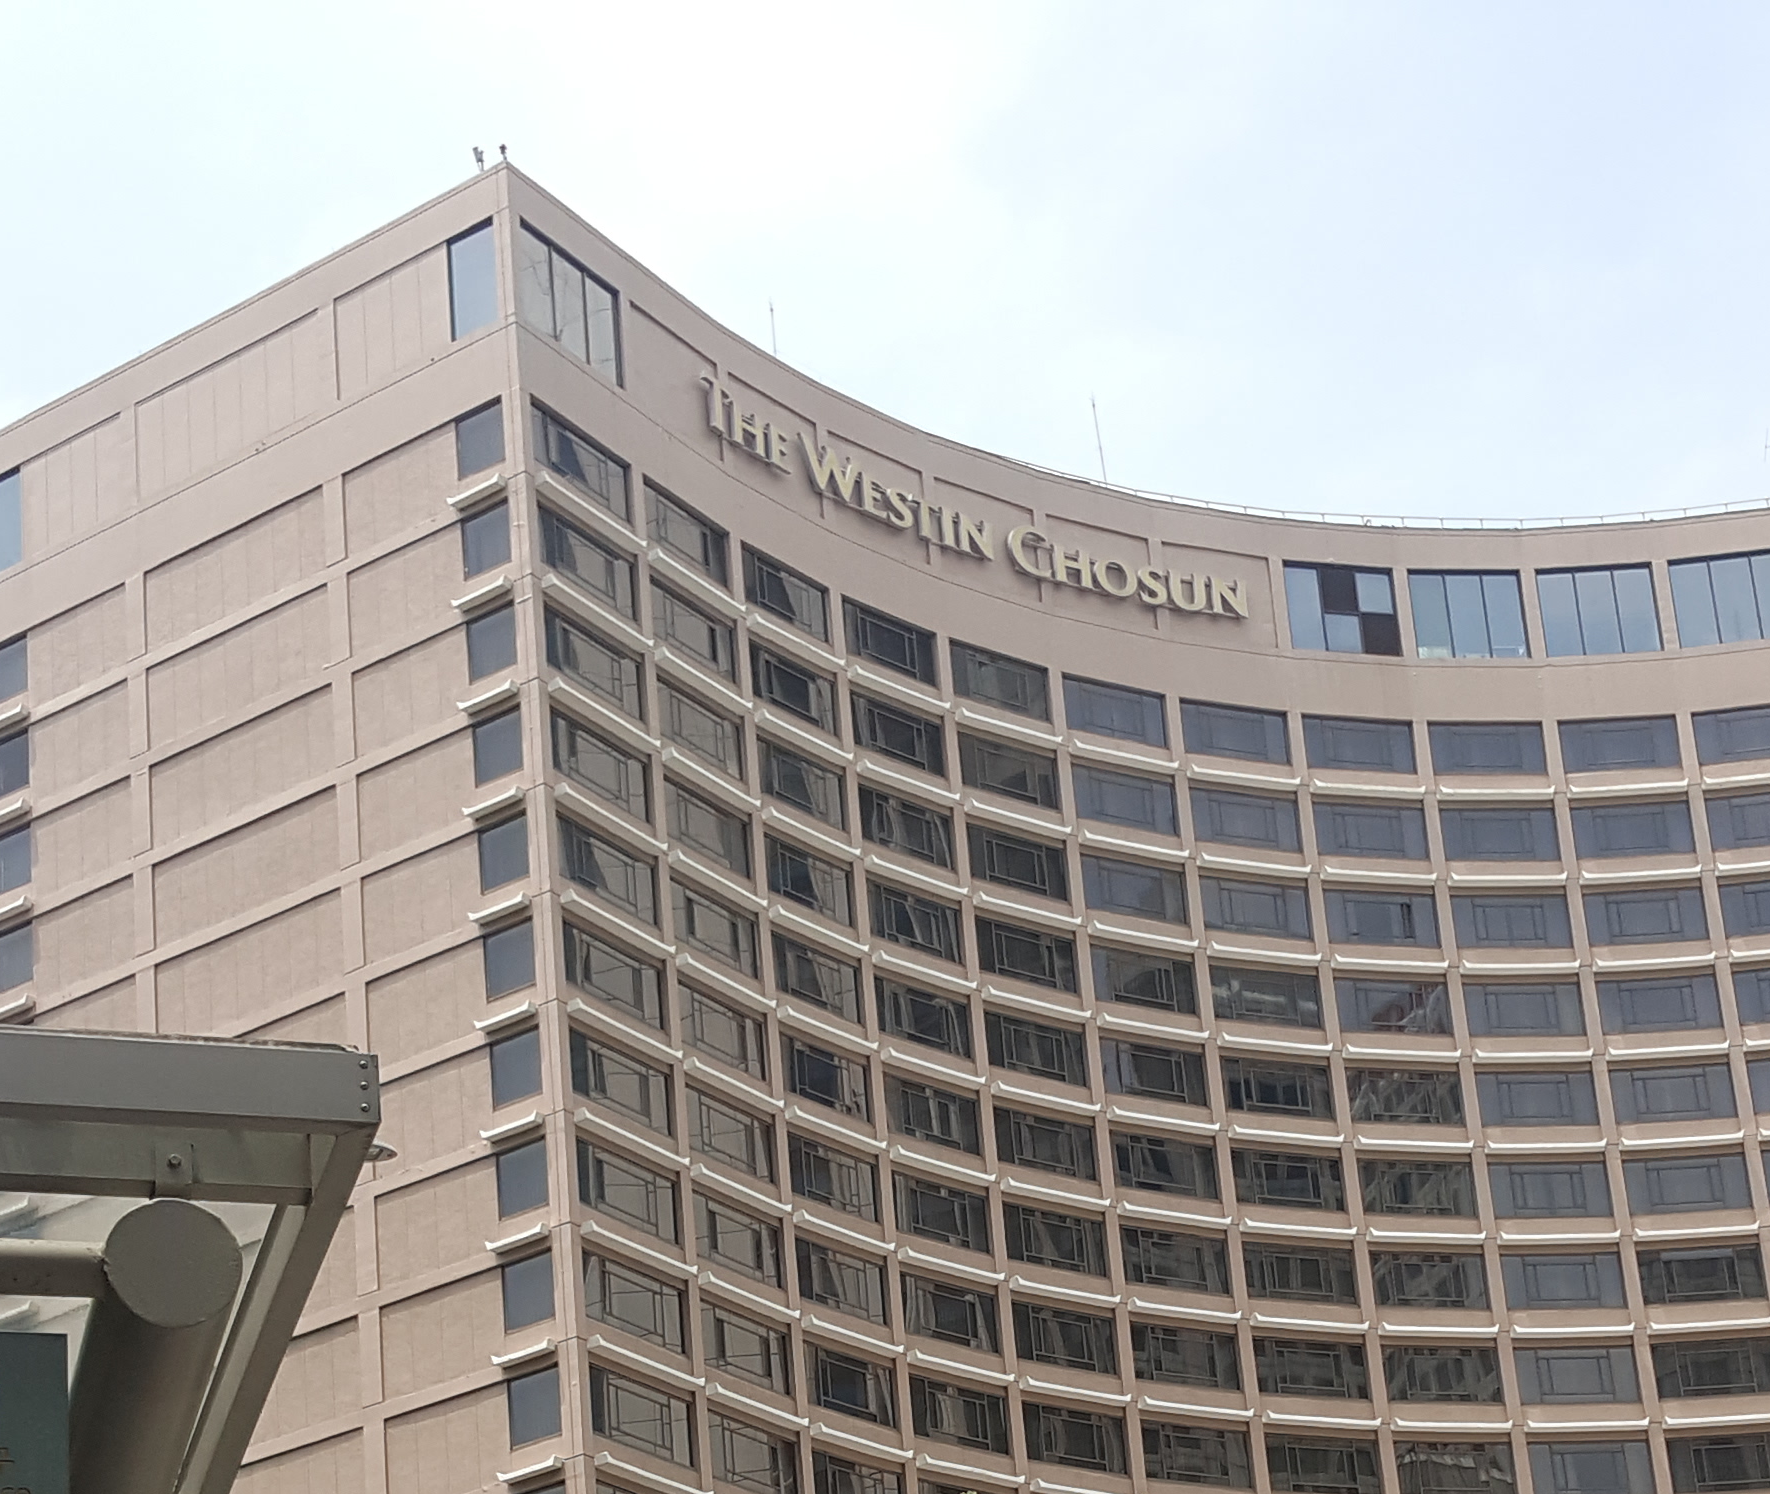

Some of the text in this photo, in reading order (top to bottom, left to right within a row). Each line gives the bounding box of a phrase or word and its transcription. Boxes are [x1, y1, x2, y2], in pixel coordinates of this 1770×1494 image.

[698, 371, 1250, 620] THE WESTIN CHOSUN
